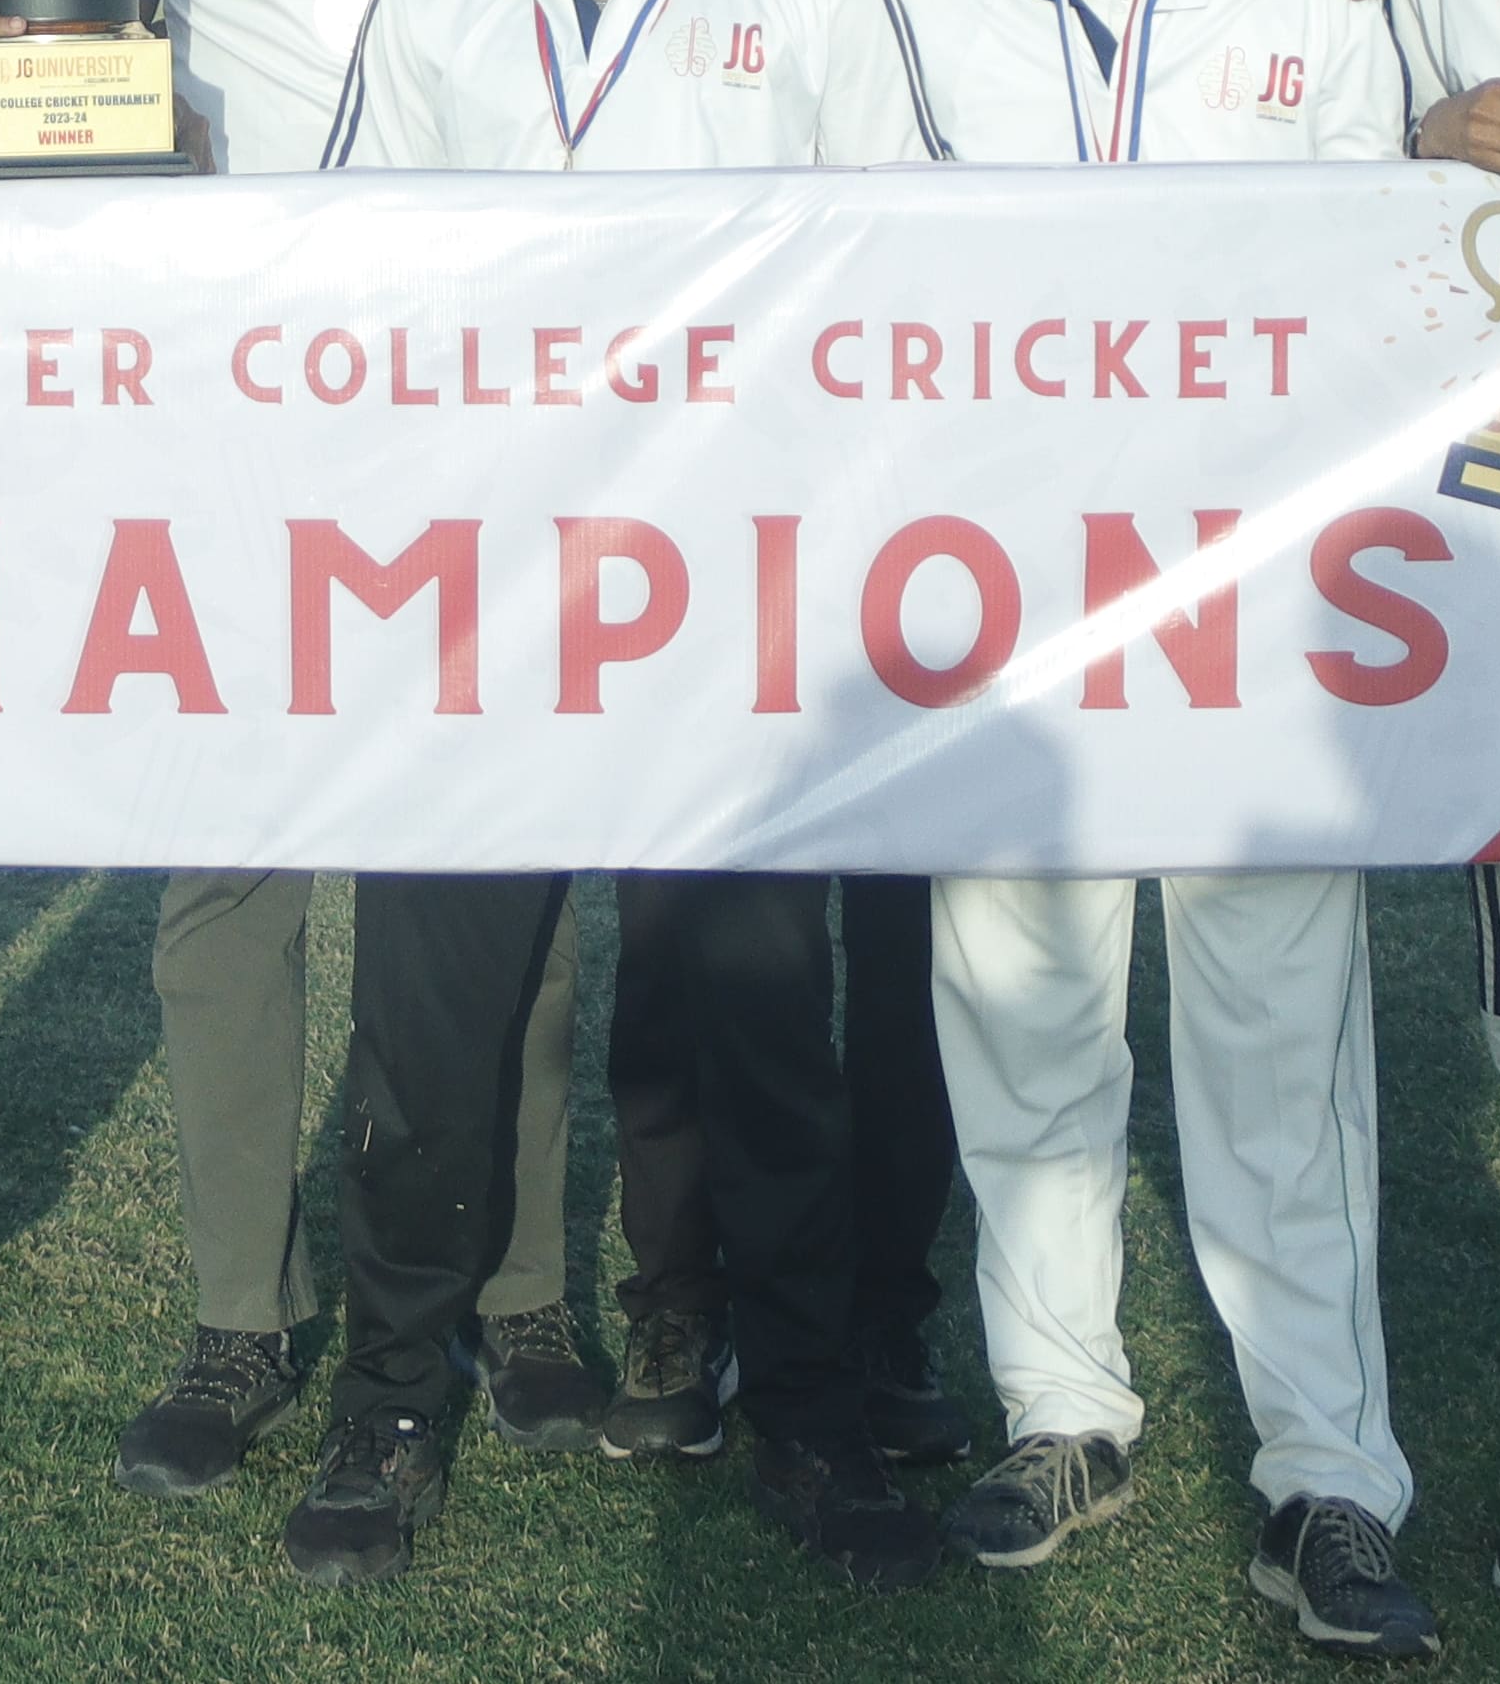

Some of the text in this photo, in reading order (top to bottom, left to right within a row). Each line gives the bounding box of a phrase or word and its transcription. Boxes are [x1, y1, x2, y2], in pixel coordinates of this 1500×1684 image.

[723, 23, 765, 73] JG
[16, 55, 133, 78] JG UNIVERSITY
[1257, 52, 1304, 107] JG
[0, 96, 42, 109] COLLEGE
[45, 95, 89, 108] CRICKET
[92, 93, 161, 107] TOURNAMENT
[43, 112, 87, 124] 2023-24
[37, 129, 94, 145] WINNER
[230, 323, 736, 407] COLLEGE
[810, 316, 1309, 402] CRICKET
